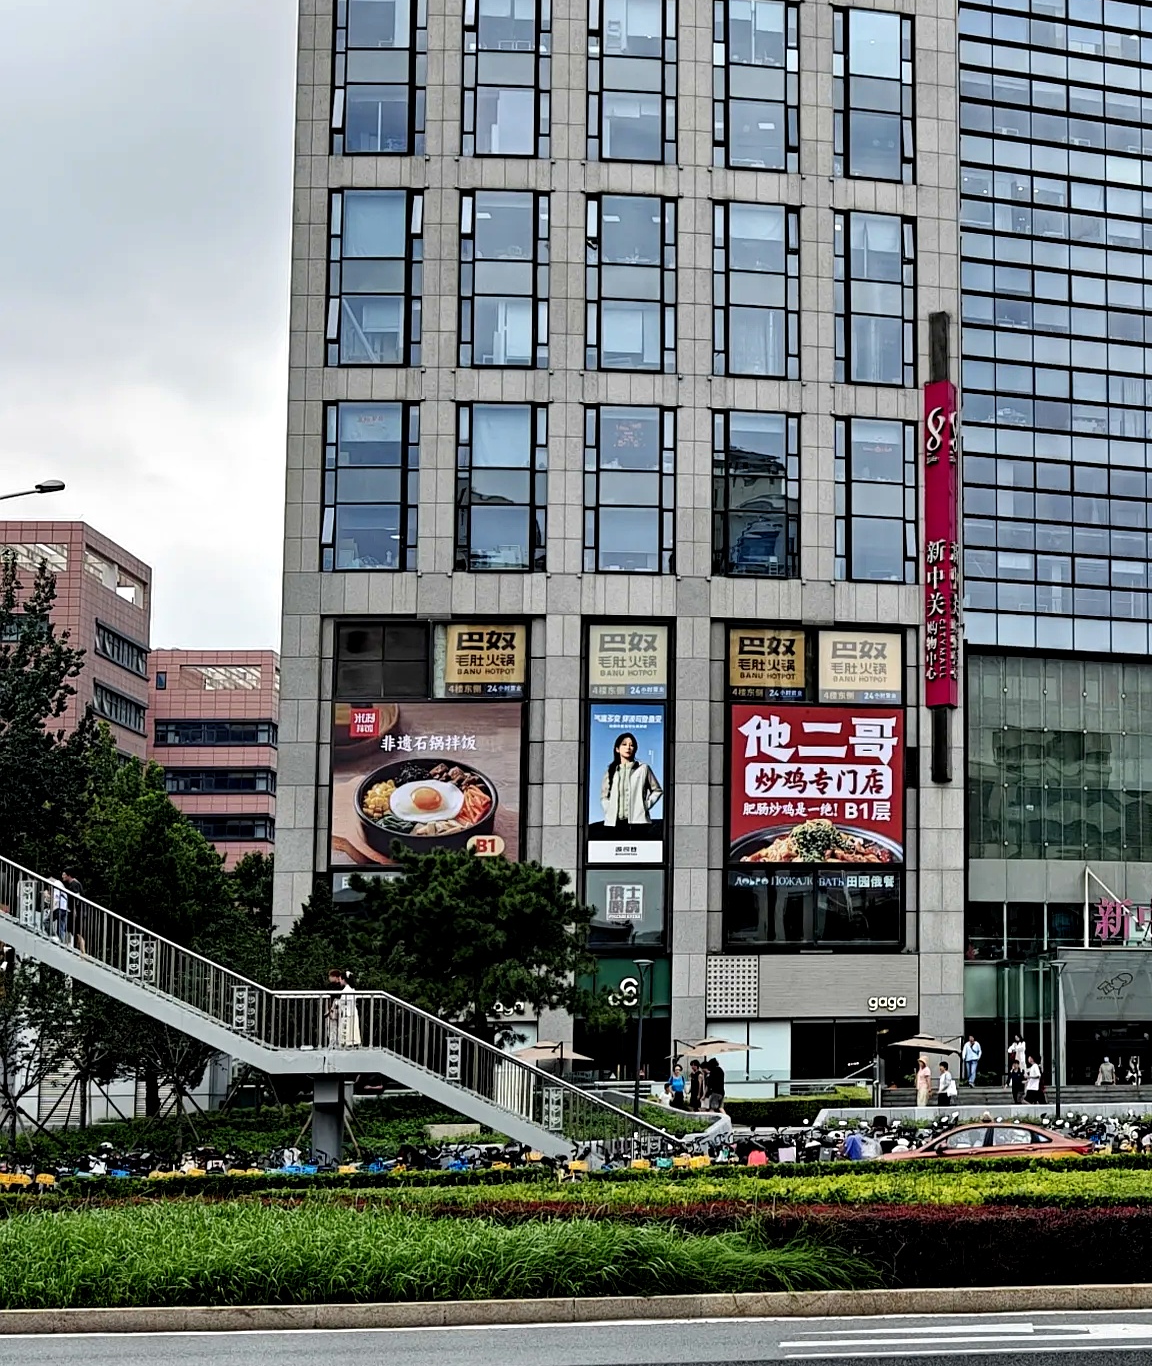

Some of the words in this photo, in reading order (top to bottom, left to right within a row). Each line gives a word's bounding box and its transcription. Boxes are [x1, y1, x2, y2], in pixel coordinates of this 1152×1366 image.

[926, 539, 946, 617] 新中关
[457, 630, 516, 651] 巴奴
[599, 632, 658, 652] 巴奴
[739, 636, 796, 656] 巴奴
[832, 640, 887, 660] 巴奴
[926, 620, 938, 680] 购物中心
[455, 654, 515, 667] 毛肚火锅
[598, 655, 657, 668] 毛肚火锅
[738, 658, 795, 671] 毛肚火锅
[831, 662, 887, 675] 毛肚火锅
[600, 669, 624, 677] BANU
[627, 669, 657, 677] HOTPOT
[833, 675, 856, 683] BANU
[380, 735, 477, 752] 非遗石锅拌饭
[738, 714, 899, 765] 他二哥
[755, 767, 885, 795] 炒鸡专门店
[845, 801, 891, 821] B1层
[475, 839, 496, 852] B1
[846, 875, 895, 888] 田园俄餐
[868, 996, 907, 1011] gaga
